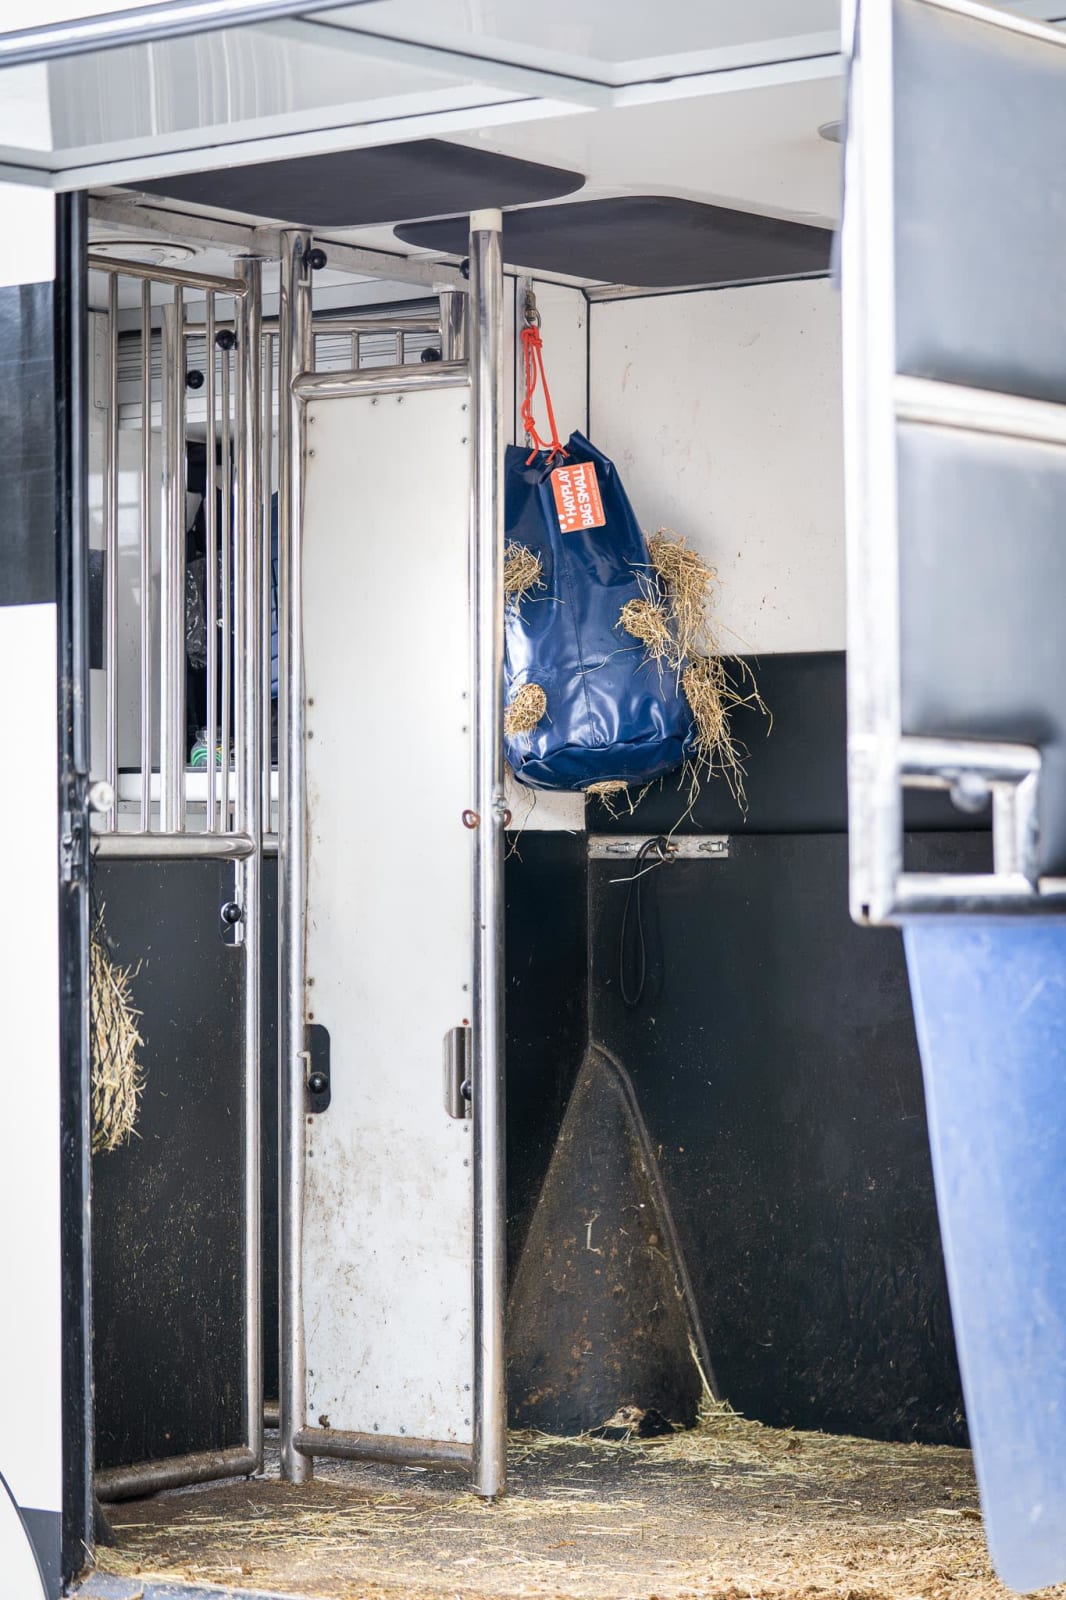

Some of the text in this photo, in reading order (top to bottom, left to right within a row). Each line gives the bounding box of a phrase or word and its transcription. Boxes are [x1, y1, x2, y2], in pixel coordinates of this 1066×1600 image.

[558, 469, 577, 517] HAYPLAY
[573, 465, 590, 503] SMALL
[580, 503, 595, 526] BAG
